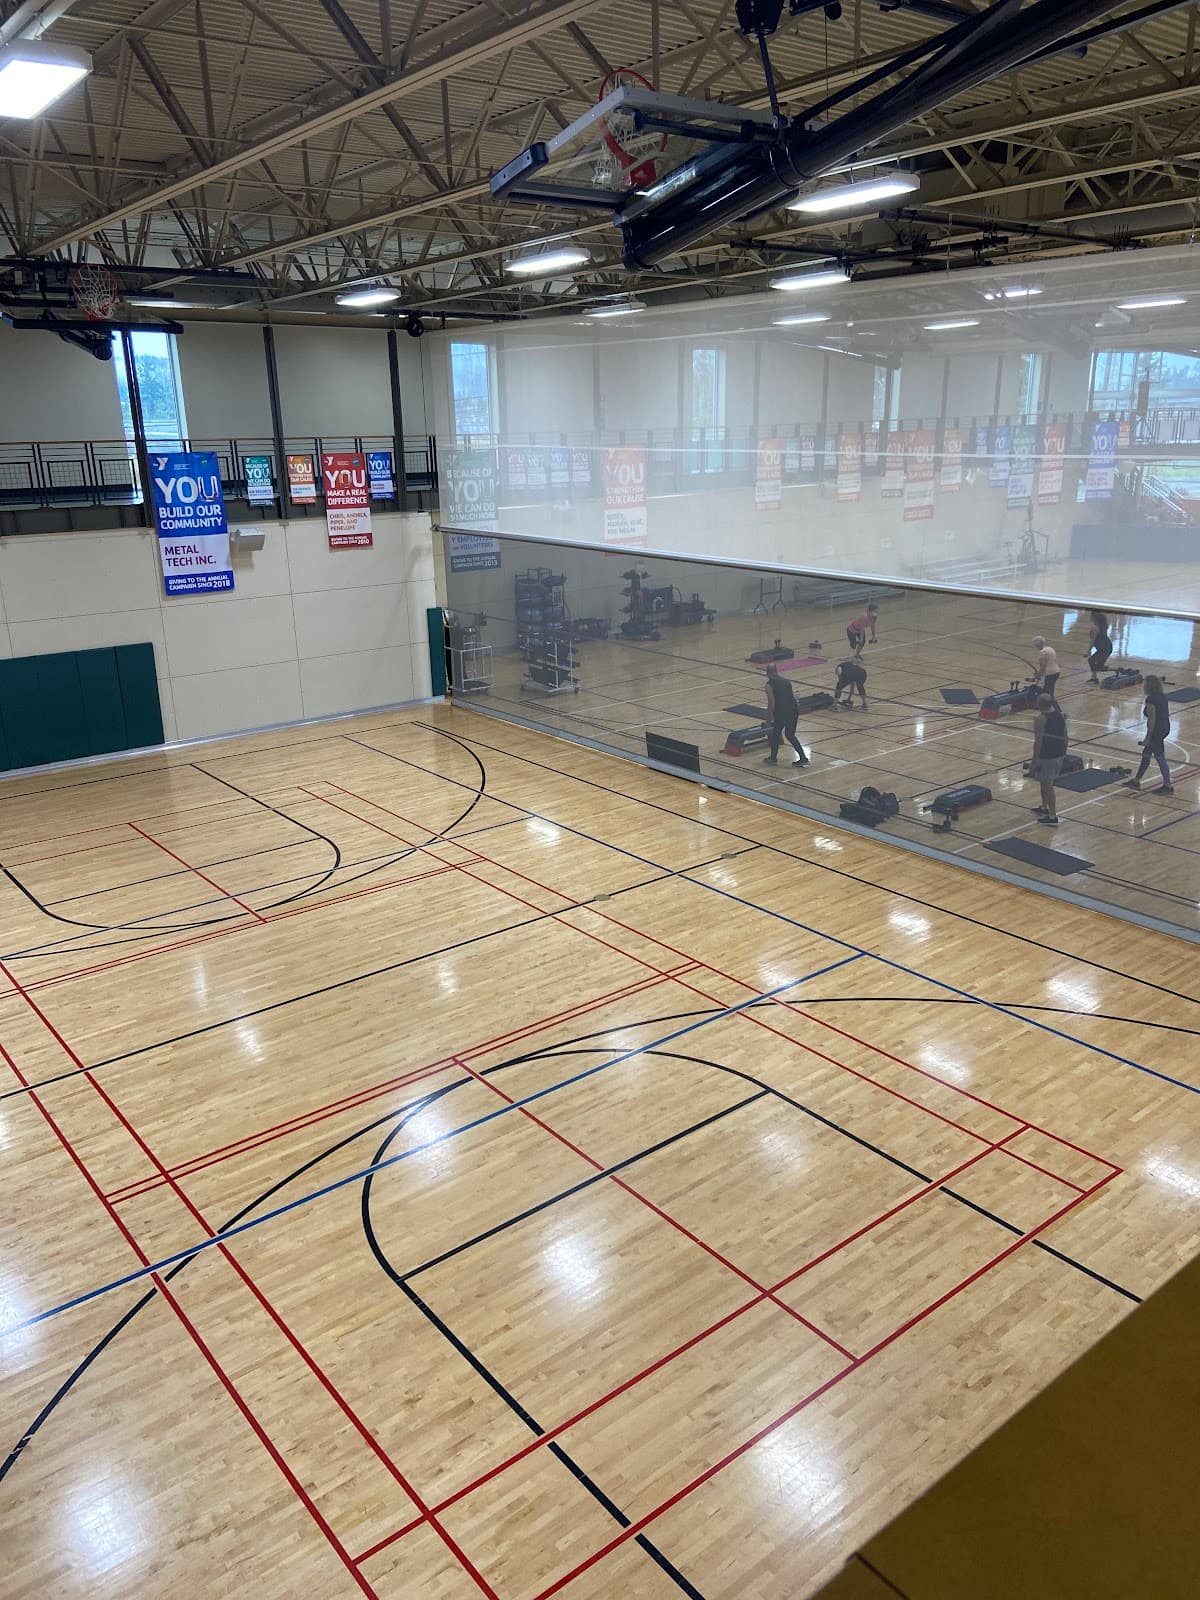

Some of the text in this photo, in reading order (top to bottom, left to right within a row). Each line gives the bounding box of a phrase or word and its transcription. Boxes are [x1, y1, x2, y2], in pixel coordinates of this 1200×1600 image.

[290, 464, 312, 474] YOU
[370, 460, 390, 470] YOU
[246, 468, 269, 478] YOU
[324, 469, 366, 489] YOU
[606, 464, 644, 485] YOU
[155, 476, 218, 504] YOU
[448, 478, 495, 503] YOU
[328, 496, 368, 506] DIFFERENCE
[159, 504, 222, 518] BUILD OUR
[465, 504, 482, 513] CAN
[483, 502, 496, 512] DO
[160, 516, 222, 530] COMMUNITY
[164, 544, 199, 556] METAL
[166, 555, 216, 567] TECH INC.
